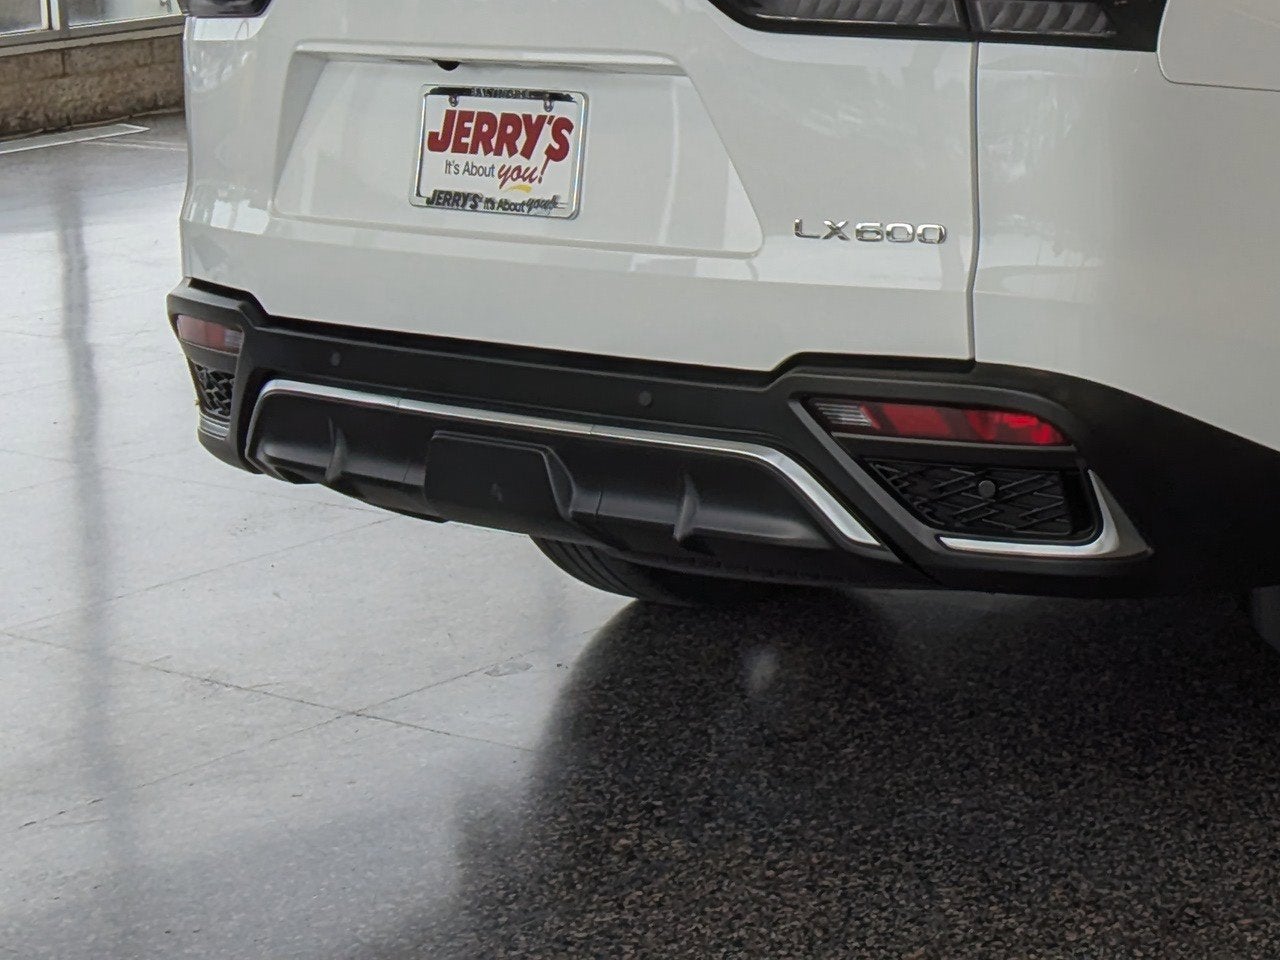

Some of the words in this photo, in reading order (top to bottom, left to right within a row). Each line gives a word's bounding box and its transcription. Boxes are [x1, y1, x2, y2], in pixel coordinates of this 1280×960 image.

[427, 108, 575, 162] JERRY'S
[444, 159, 461, 175] It's
[462, 160, 496, 179] About
[497, 155, 549, 190] you!
[794, 218, 948, 245] LX600
